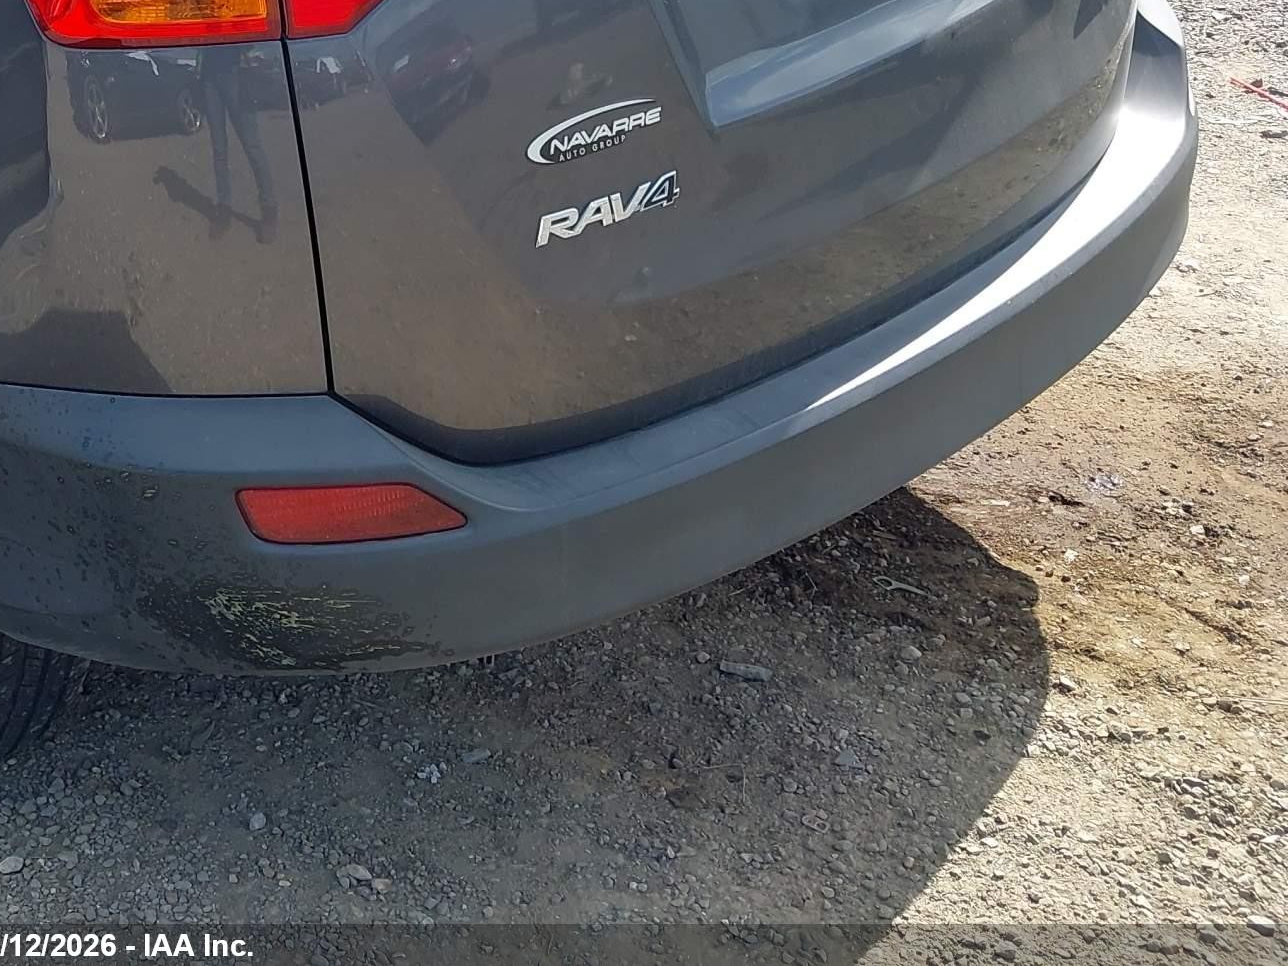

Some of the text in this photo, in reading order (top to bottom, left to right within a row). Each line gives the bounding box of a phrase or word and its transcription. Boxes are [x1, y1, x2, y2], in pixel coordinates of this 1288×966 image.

[550, 106, 661, 155] NAVARRE
[559, 134, 626, 162] AUTO GROUP
[536, 170, 680, 248] RAV4
